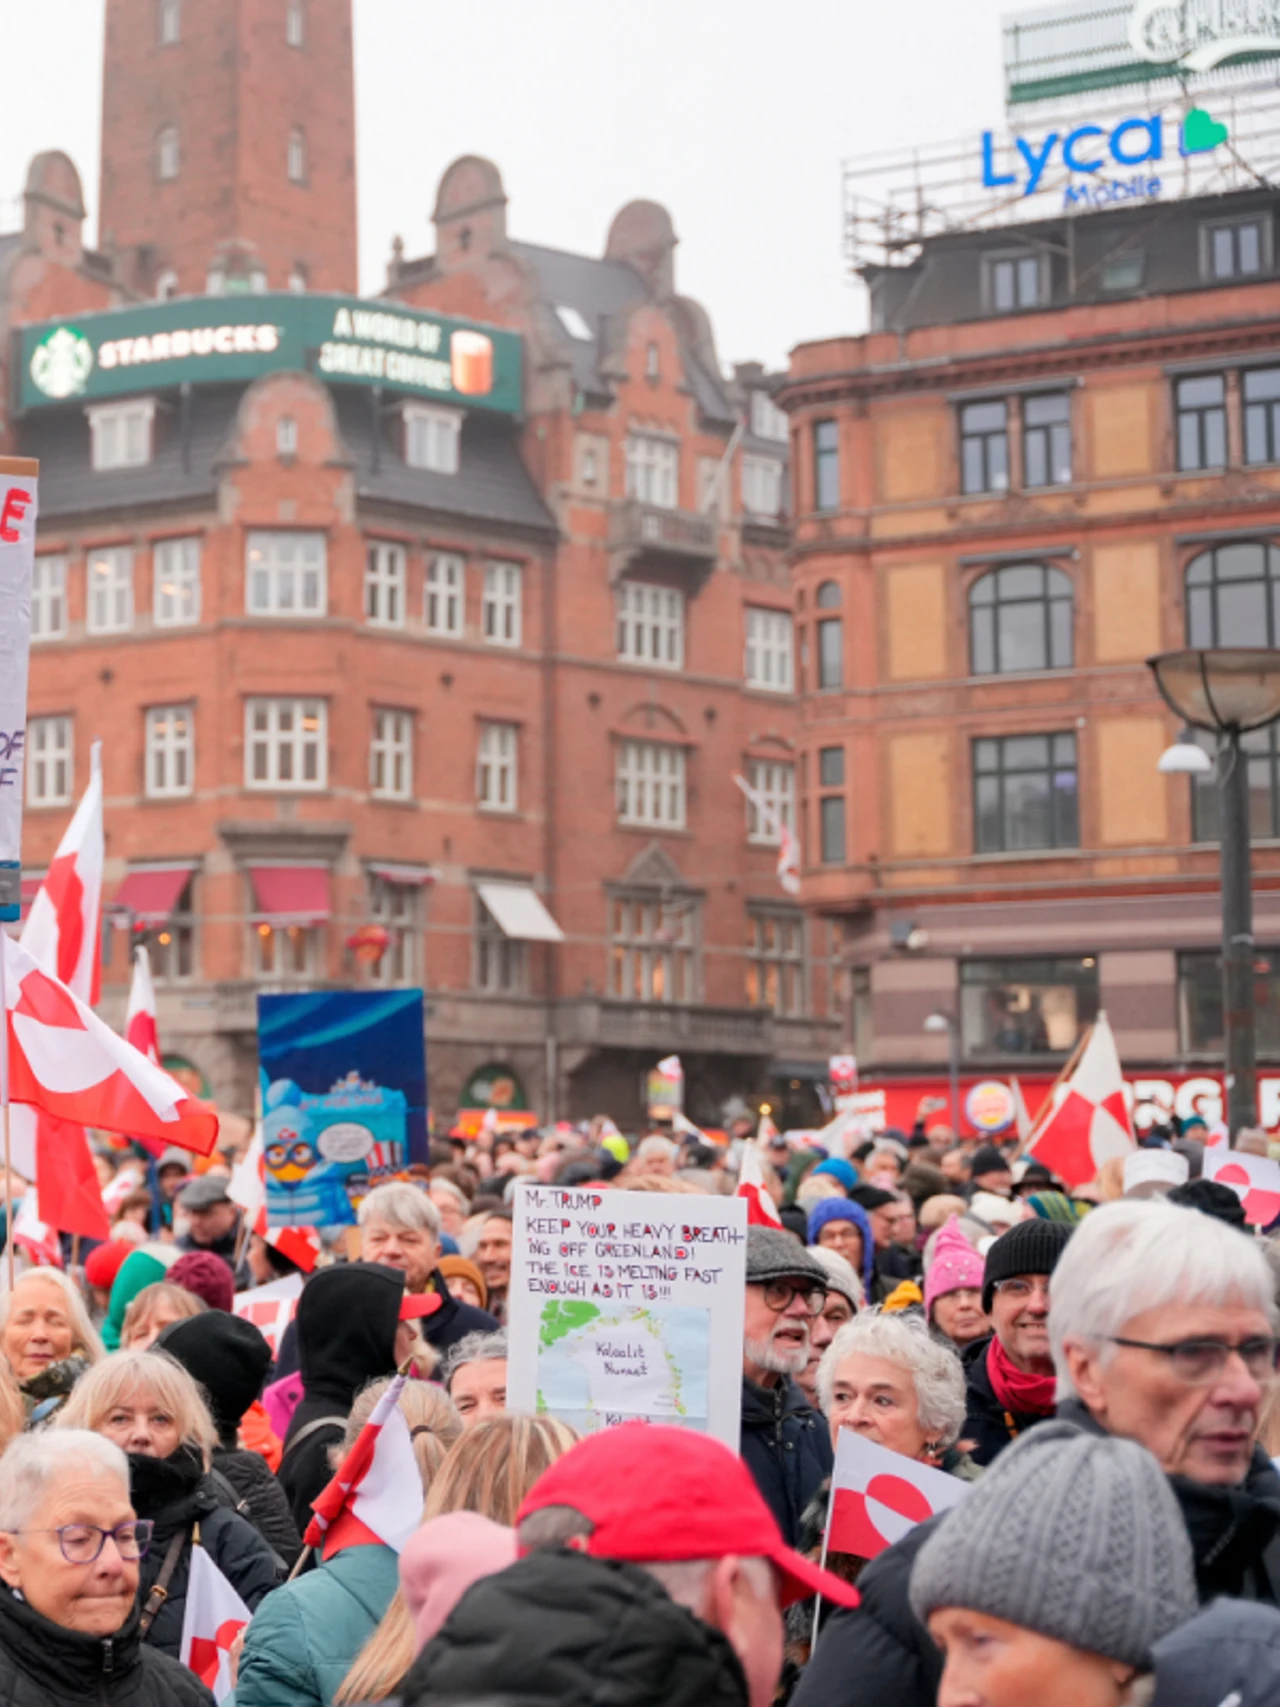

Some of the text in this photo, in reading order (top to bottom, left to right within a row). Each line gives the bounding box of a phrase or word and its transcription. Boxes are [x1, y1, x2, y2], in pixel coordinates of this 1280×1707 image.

[980, 114, 1163, 196] Lyca
[1063, 176, 1161, 209] Mobile
[332, 307, 442, 353] A WORLD OF
[98, 323, 279, 369] STARBUCKS
[318, 342, 385, 377] GREAT
[551, 1191, 602, 1211] TRUMP
[526, 1217, 570, 1235] KEEP
[577, 1221, 617, 1240] YOUR
[623, 1222, 675, 1239] HEAVY
[559, 1243, 587, 1257] OFF
[595, 1243, 695, 1260] GREENLAND!
[526, 1260, 558, 1275] THE
[618, 1264, 677, 1281] MELTING
[684, 1267, 723, 1285] FAST
[528, 1278, 586, 1296] ENOUGH
[592, 1282, 613, 1298] AS
